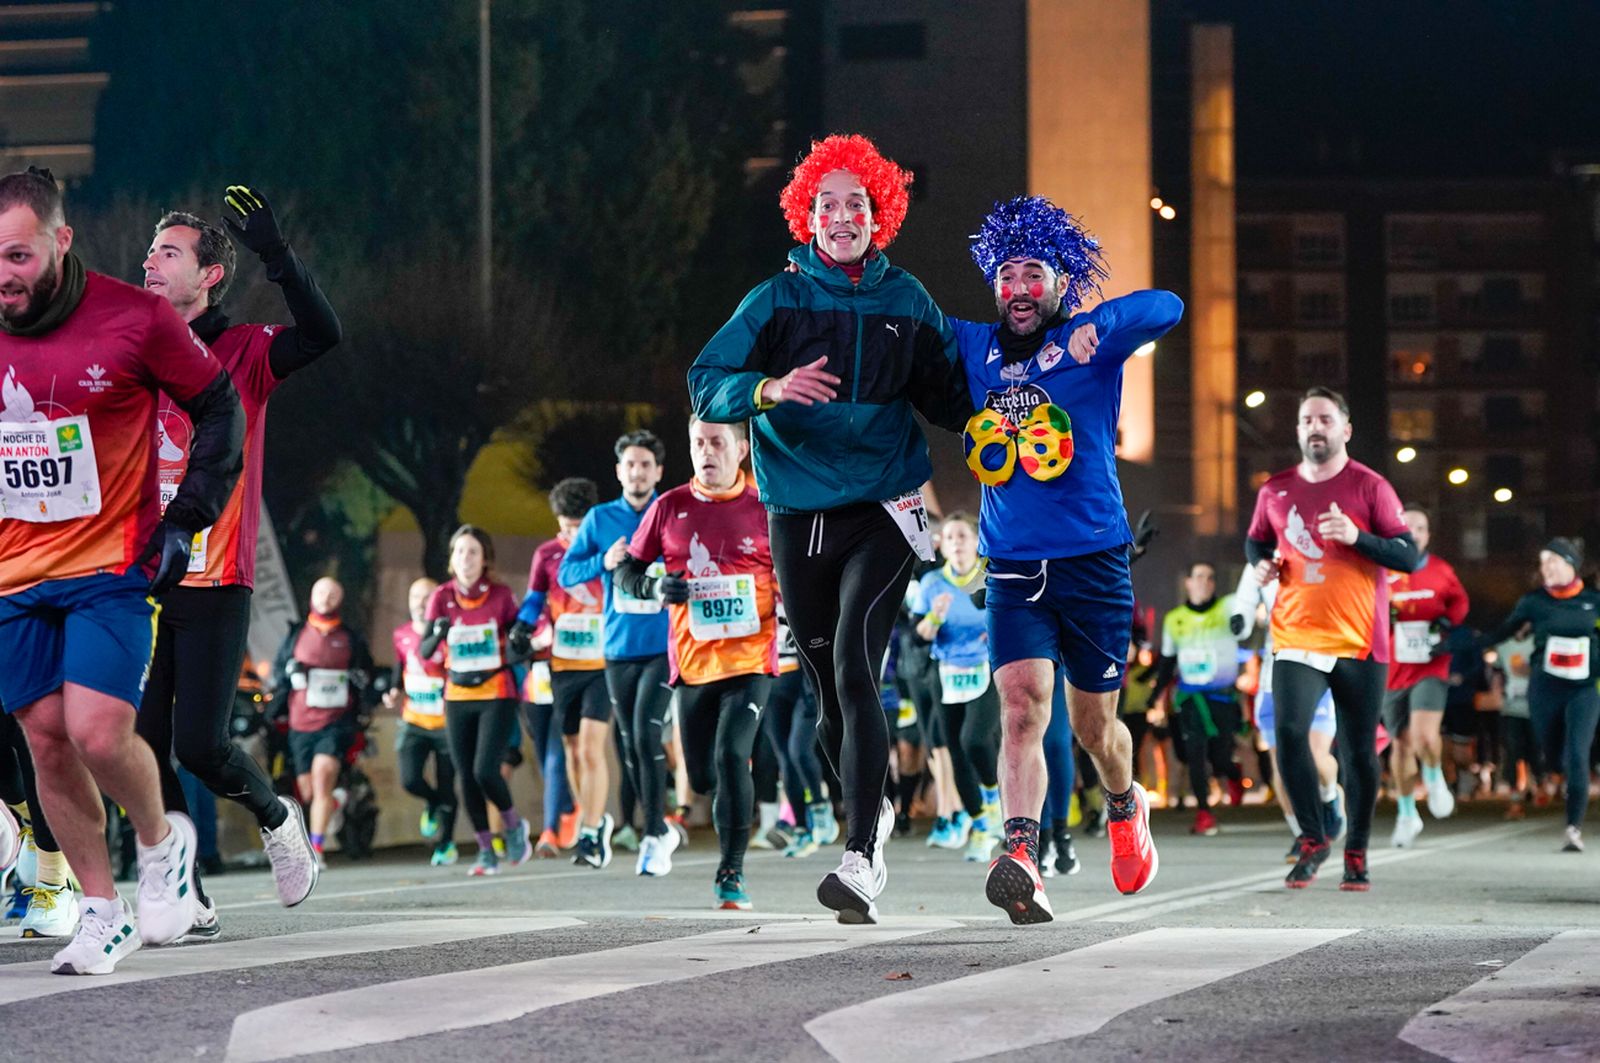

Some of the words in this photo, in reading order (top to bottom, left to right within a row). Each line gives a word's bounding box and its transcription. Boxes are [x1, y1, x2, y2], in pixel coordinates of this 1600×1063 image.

[3, 434, 33, 443] NOCHE
[36, 434, 47, 443] DE
[0, 447, 13, 457] AN
[15, 443, 49, 457] ANTÓN
[4, 456, 73, 489] 5697
[896, 499, 913, 512] SAN
